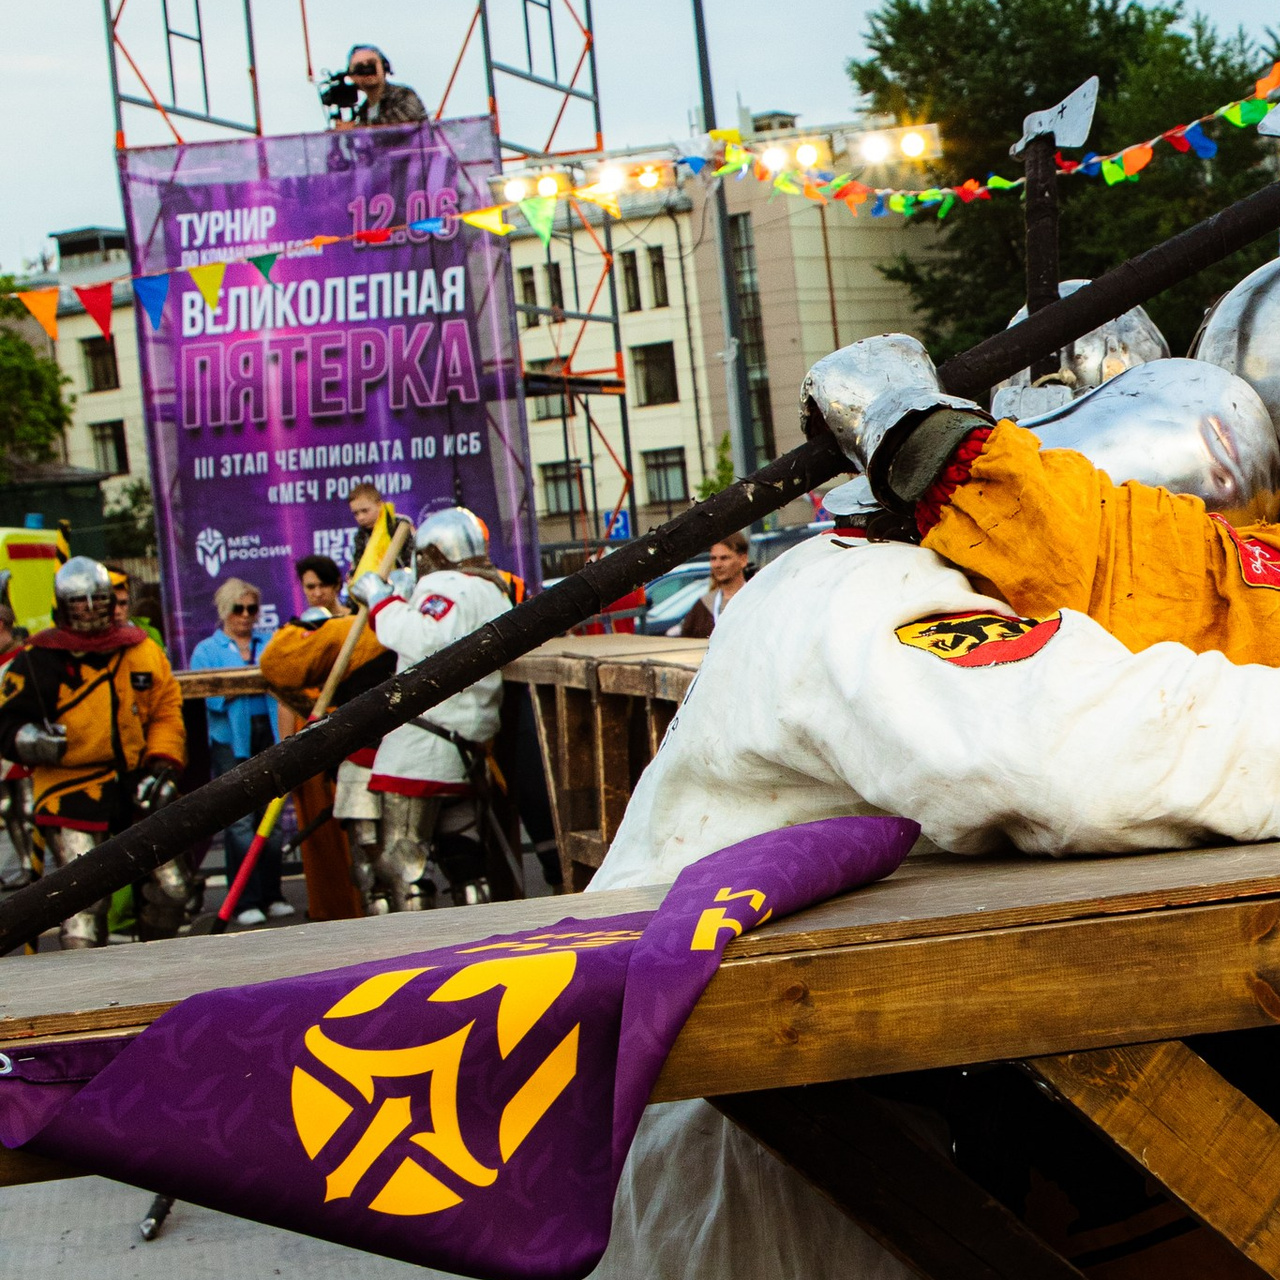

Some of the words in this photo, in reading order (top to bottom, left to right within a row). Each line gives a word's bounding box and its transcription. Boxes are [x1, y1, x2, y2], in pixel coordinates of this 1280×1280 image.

[175, 206, 277, 248] ТУРНИР
[348, 187, 460, 248] 12.06
[181, 266, 466, 337] ВЕЛИКОЛЕПНАЯ
[181, 319, 480, 429] ПЯТЕРКА
[220, 451, 269, 477] ЭТАП
[274, 439, 404, 472] ЧЕМПИОНАТА
[410, 435, 436, 460] ПО
[443, 431, 482, 456] ИСБ
[267, 479, 319, 505] «МЕЧ
[227, 535, 261, 548] МЕЧ
[228, 544, 293, 561] РОССИИ
